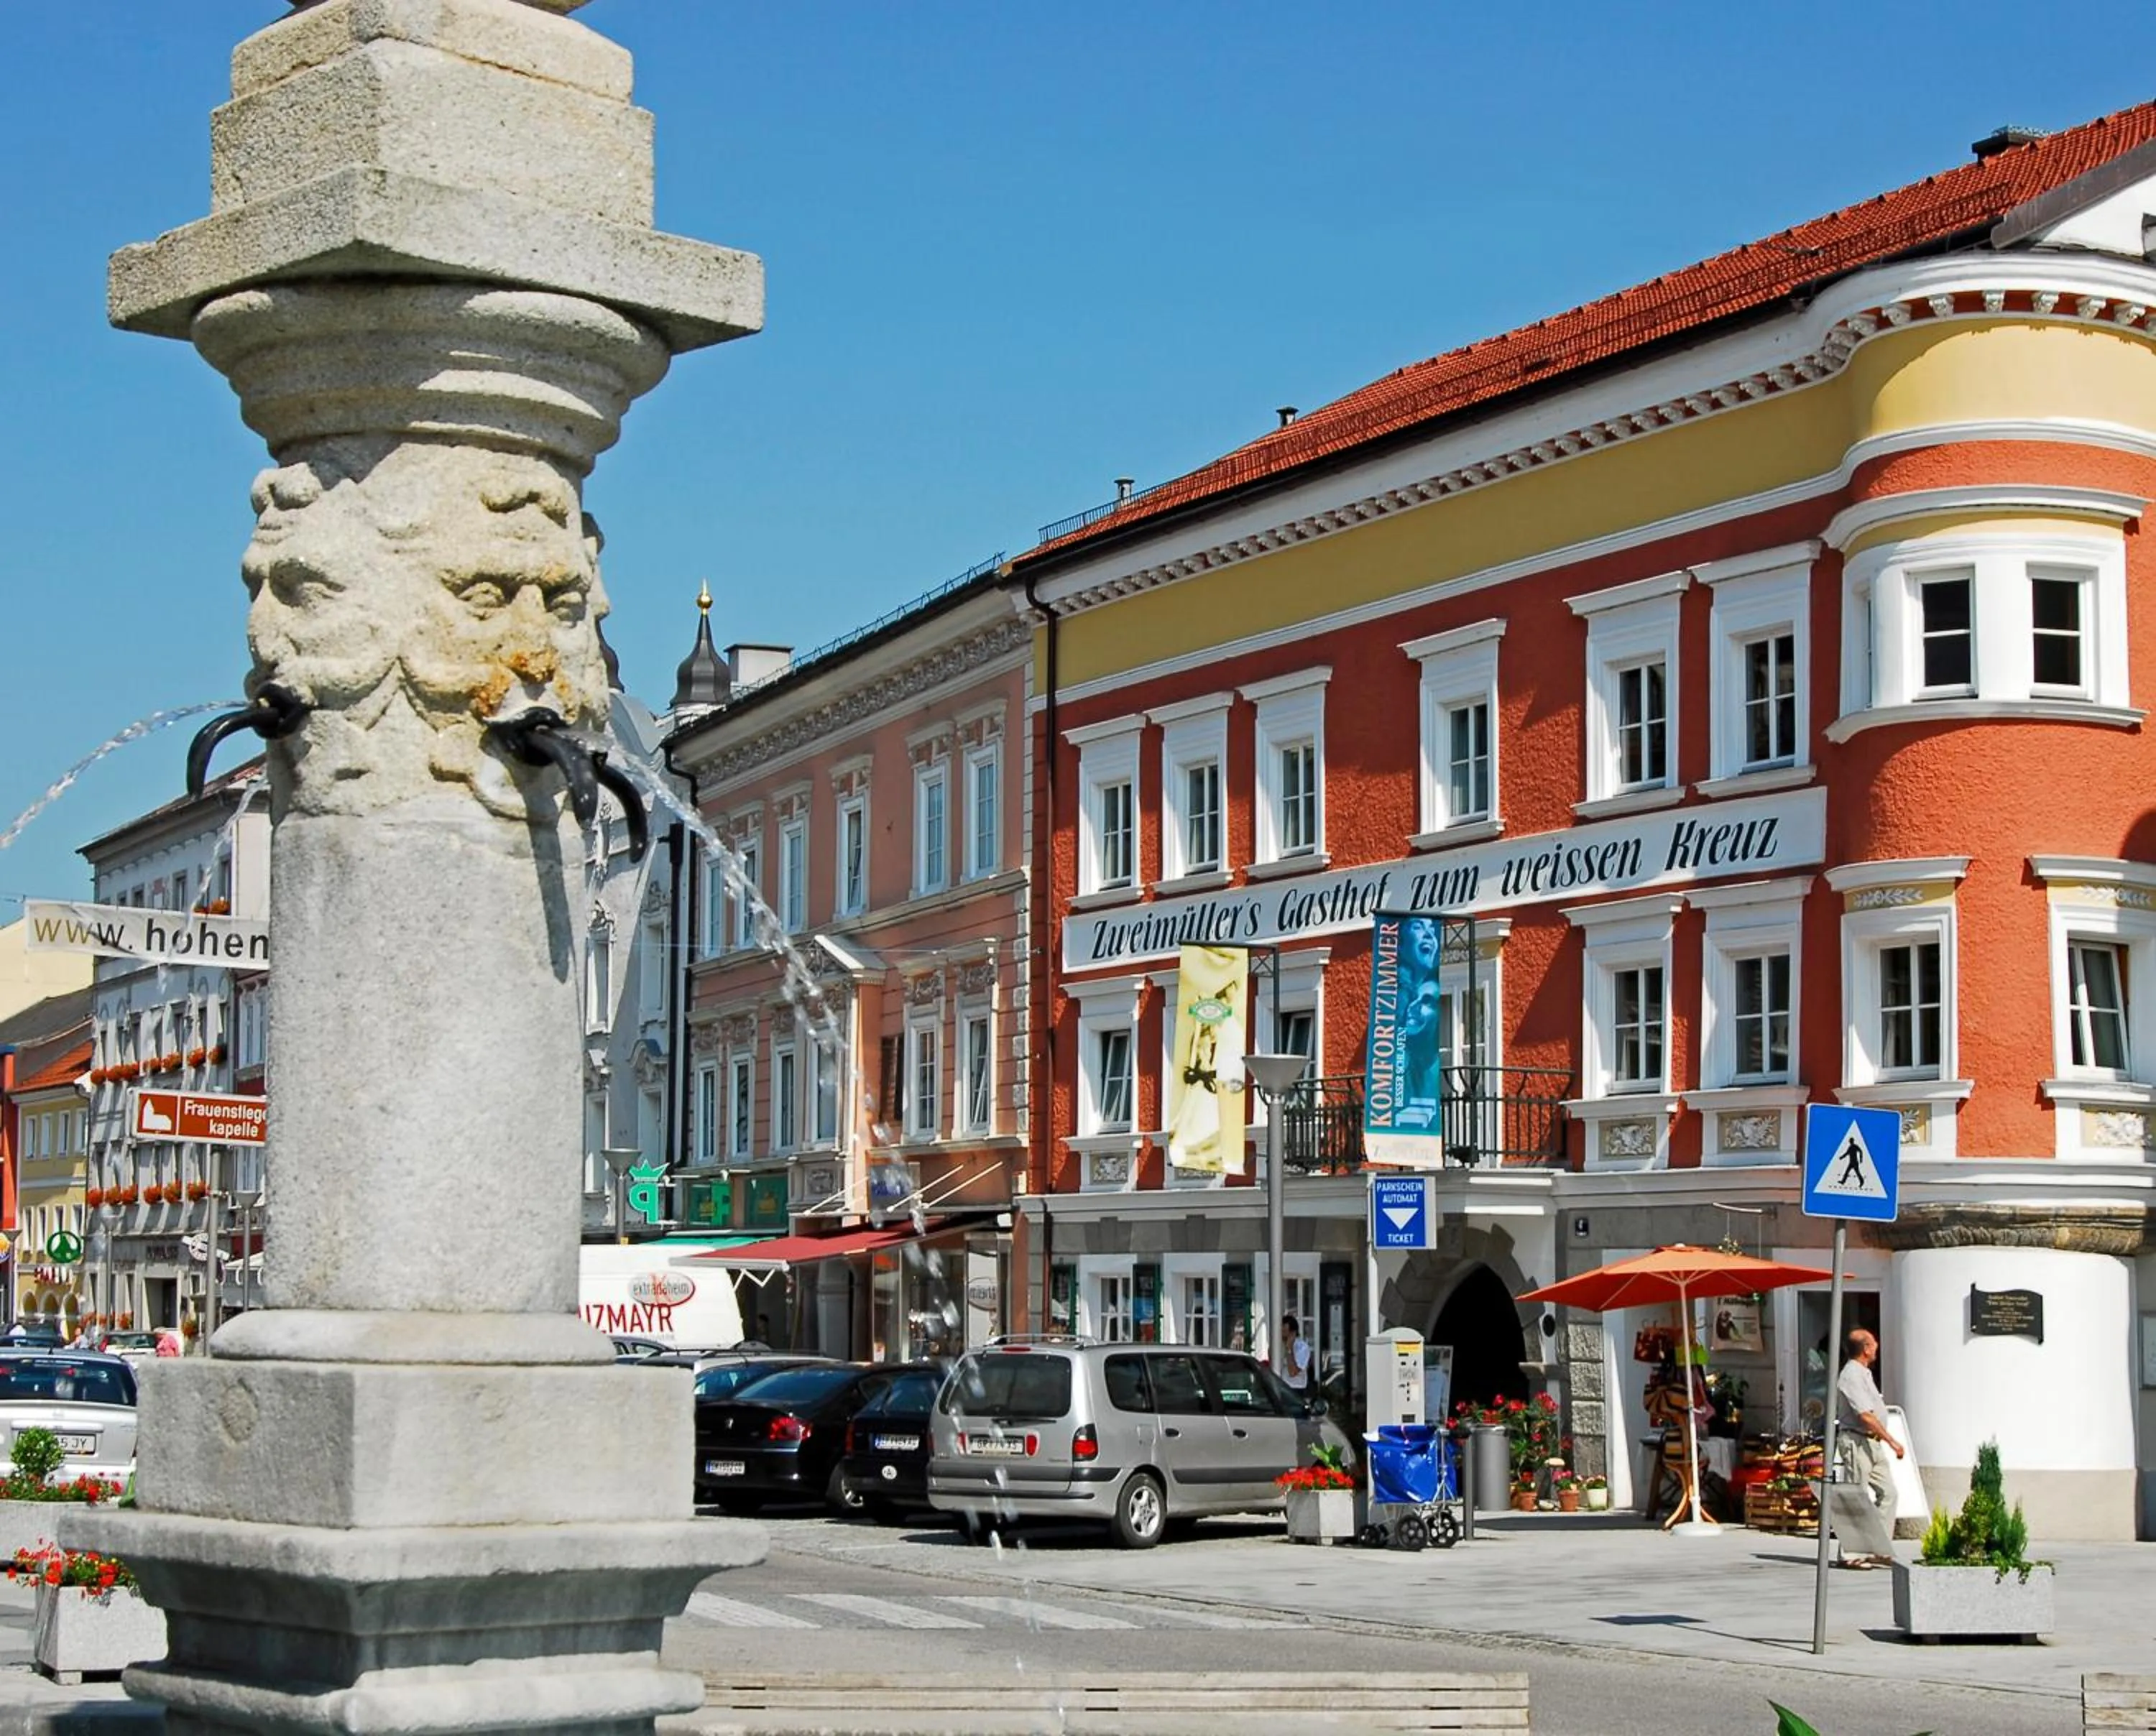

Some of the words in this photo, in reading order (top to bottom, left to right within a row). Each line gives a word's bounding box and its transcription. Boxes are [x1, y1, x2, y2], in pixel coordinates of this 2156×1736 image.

[1277, 871, 1391, 930] Gasthof
[1409, 864, 1480, 911] zum
[1501, 836, 1643, 897] weissen
[1664, 816, 1780, 872] Kreuz
[1370, 922, 1399, 1127] KOMFORTZIMMER
[209, 1119, 258, 1138] kapelle
[1376, 1182, 1423, 1193] PARKSCHEIN
[1382, 1194, 1417, 1204] AUTOMAT
[1387, 1233, 1414, 1243] TICKET
